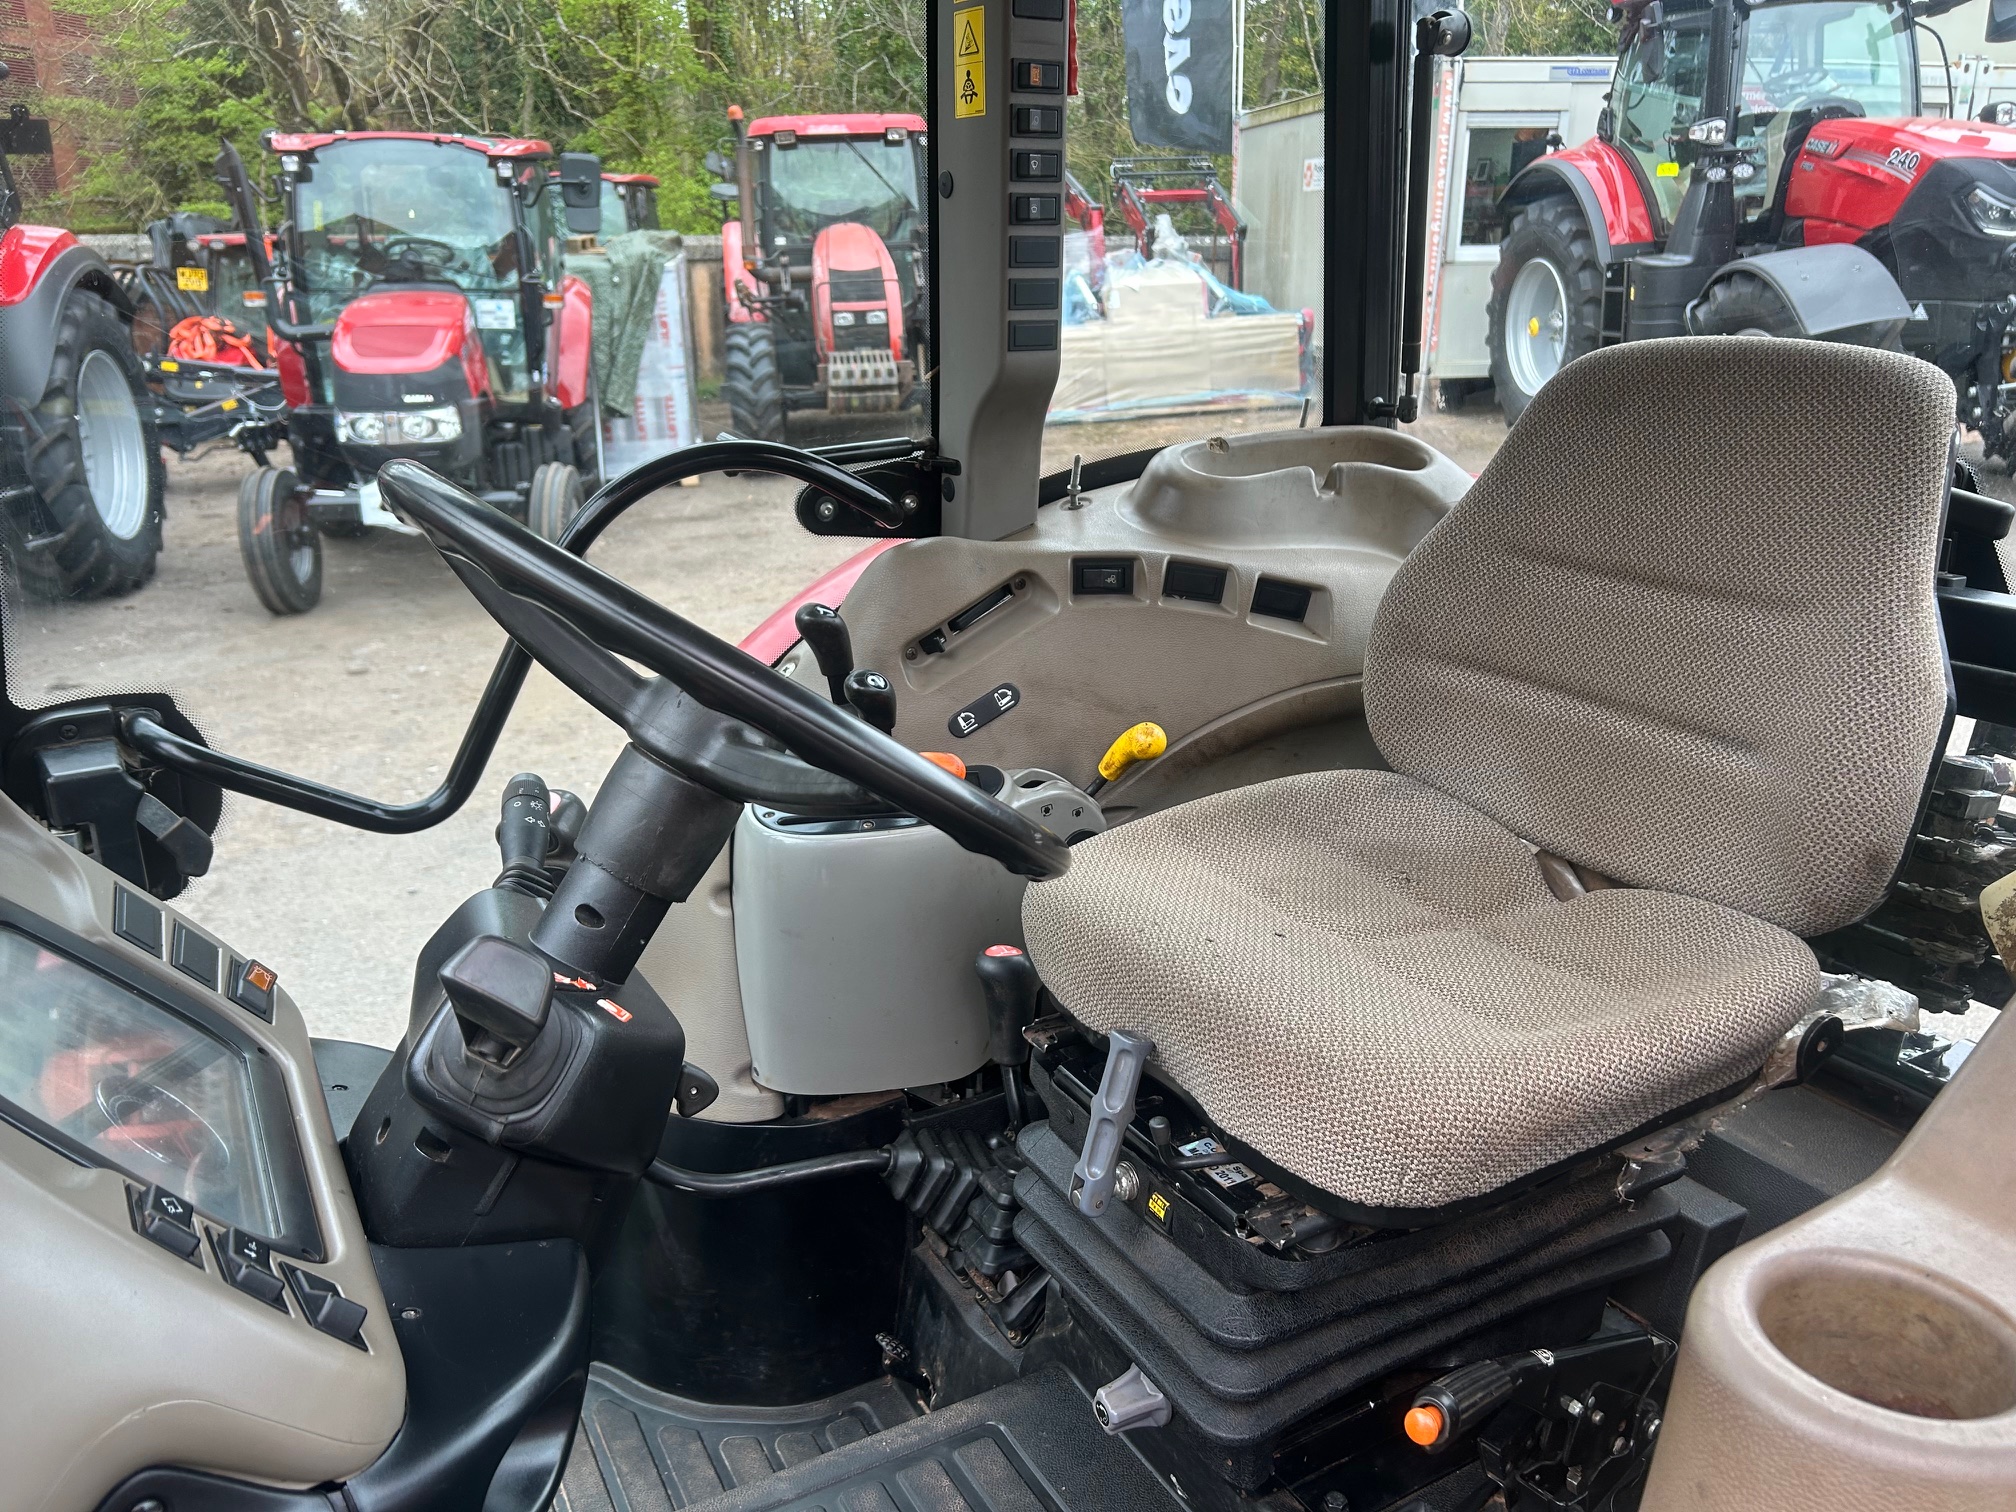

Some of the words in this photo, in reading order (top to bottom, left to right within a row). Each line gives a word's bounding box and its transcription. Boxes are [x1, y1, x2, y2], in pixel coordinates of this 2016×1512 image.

[1886, 147, 1920, 170] 240
[866, 675, 886, 689] 2
[1215, 1167, 1237, 1185] 2011
